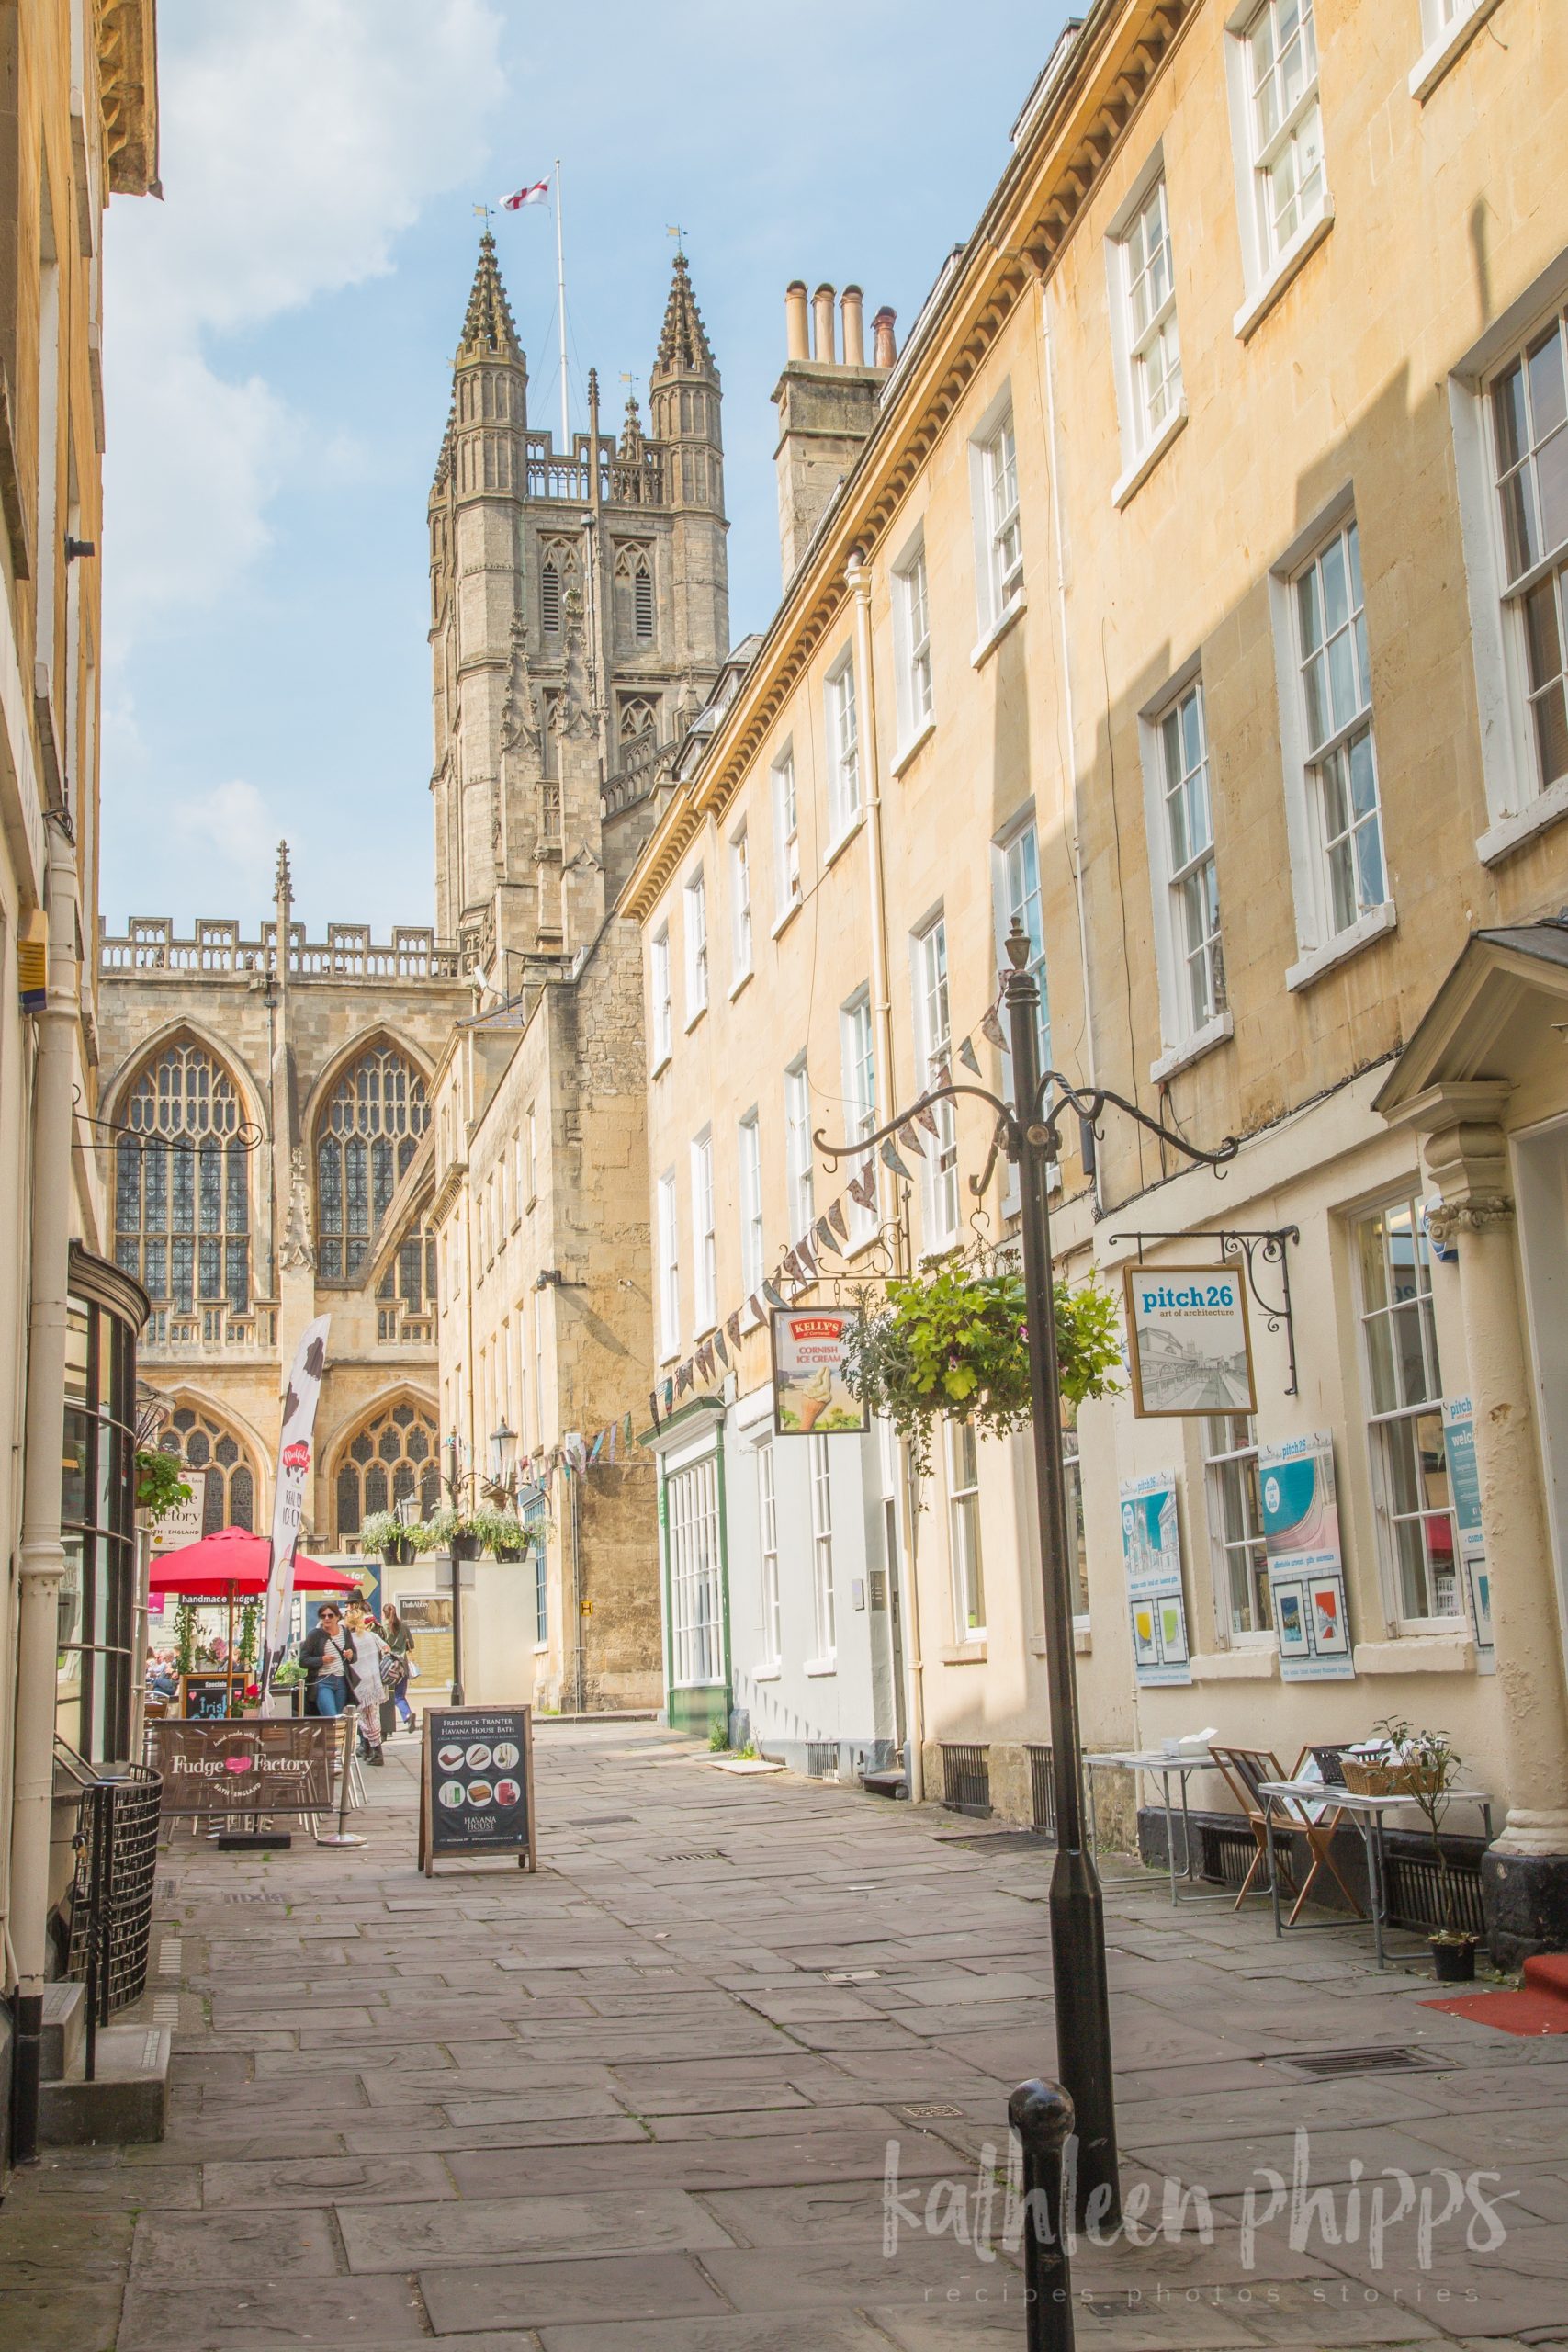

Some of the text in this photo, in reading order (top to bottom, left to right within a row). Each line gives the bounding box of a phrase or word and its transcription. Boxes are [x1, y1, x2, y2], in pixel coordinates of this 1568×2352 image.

[1141, 1285, 1234, 1313] pitch26
[1183, 1308, 1235, 1317] architecture
[794, 1321, 839, 1333] KELLY'S
[798, 1346, 838, 1355] CORNISH
[796, 1355, 841, 1364] ICE CREAM
[1281, 1438, 1306, 1460] pitch26
[351, 1571, 365, 1580] for
[581, 1602, 592, 1614] H
[171, 1753, 314, 1777] Fudge Factory
[213, 1782, 262, 1797] BATH ENGLAND
[464, 1816, 497, 1825] HAVANA
[468, 1822, 495, 1830] HOUSE
